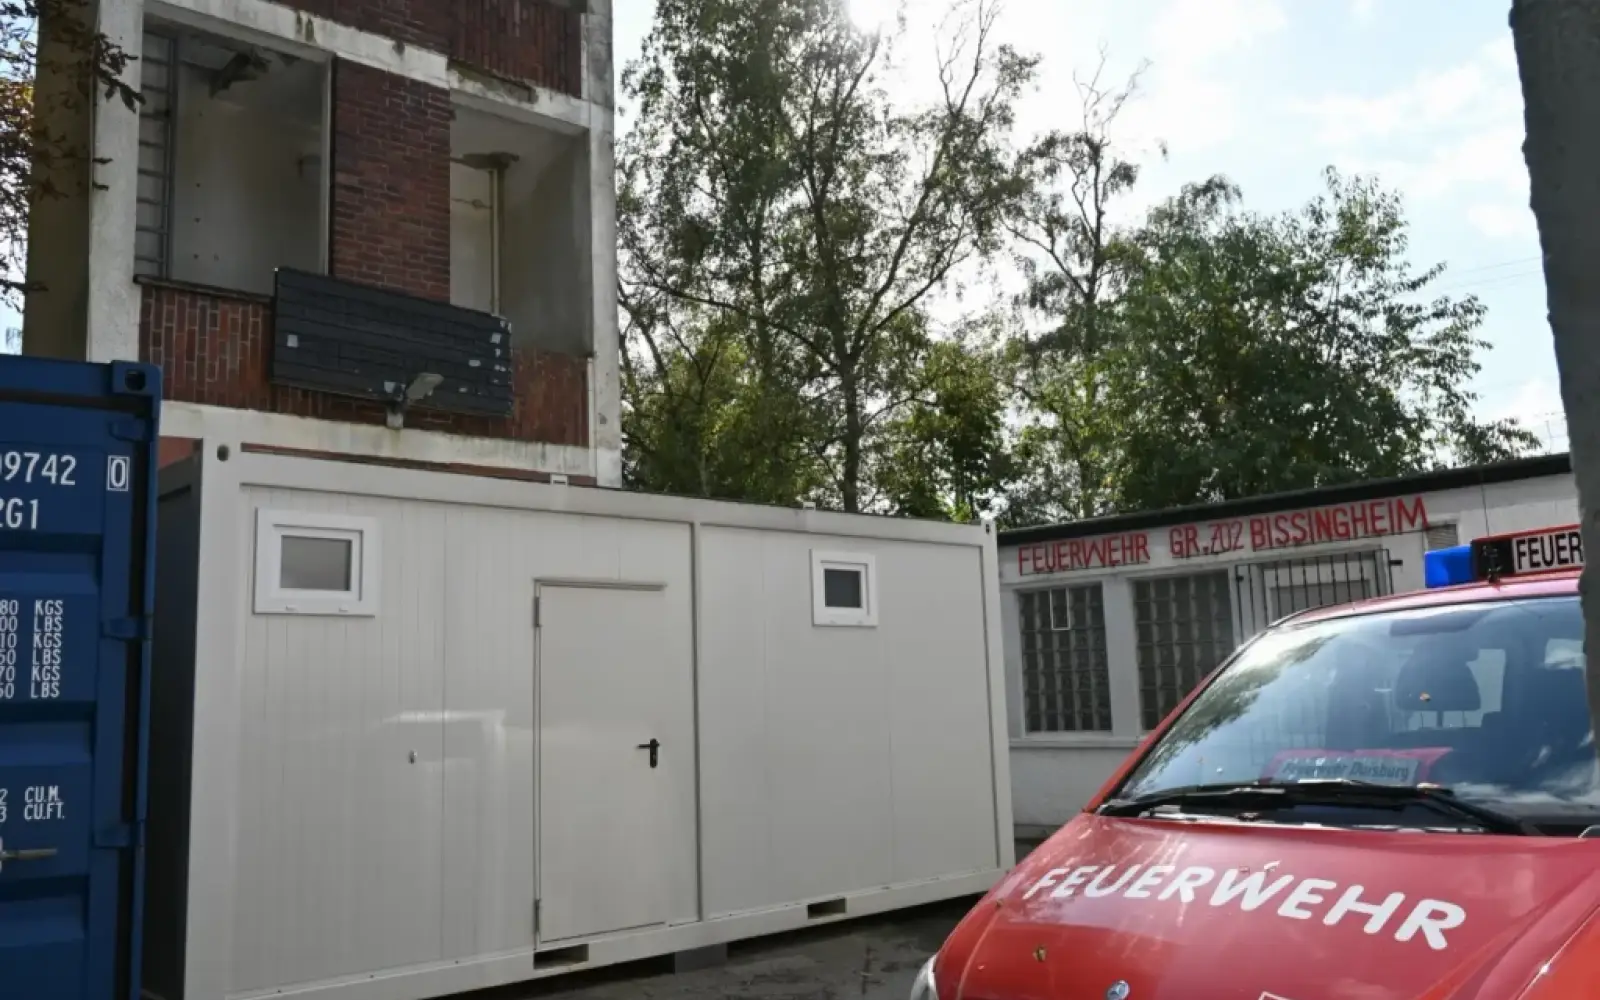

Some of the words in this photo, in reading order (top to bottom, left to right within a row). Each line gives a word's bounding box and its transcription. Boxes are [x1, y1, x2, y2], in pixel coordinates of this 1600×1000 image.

[0, 451, 77, 486] 9742
[109, 458, 127, 488] 0
[0, 498, 39, 530] G1
[1018, 532, 1151, 576] FEUERWEHR
[1251, 496, 1430, 552] BISSINGHEIM
[1515, 531, 1583, 570] FEUER
[34, 599, 64, 616] KGS
[33, 616, 63, 632] LBS
[33, 633, 62, 649] KGS
[32, 649, 62, 665] LBS
[31, 665, 61, 682] KGS
[30, 682, 60, 699] LBS
[1022, 864, 1467, 950] FEUERWEHR
